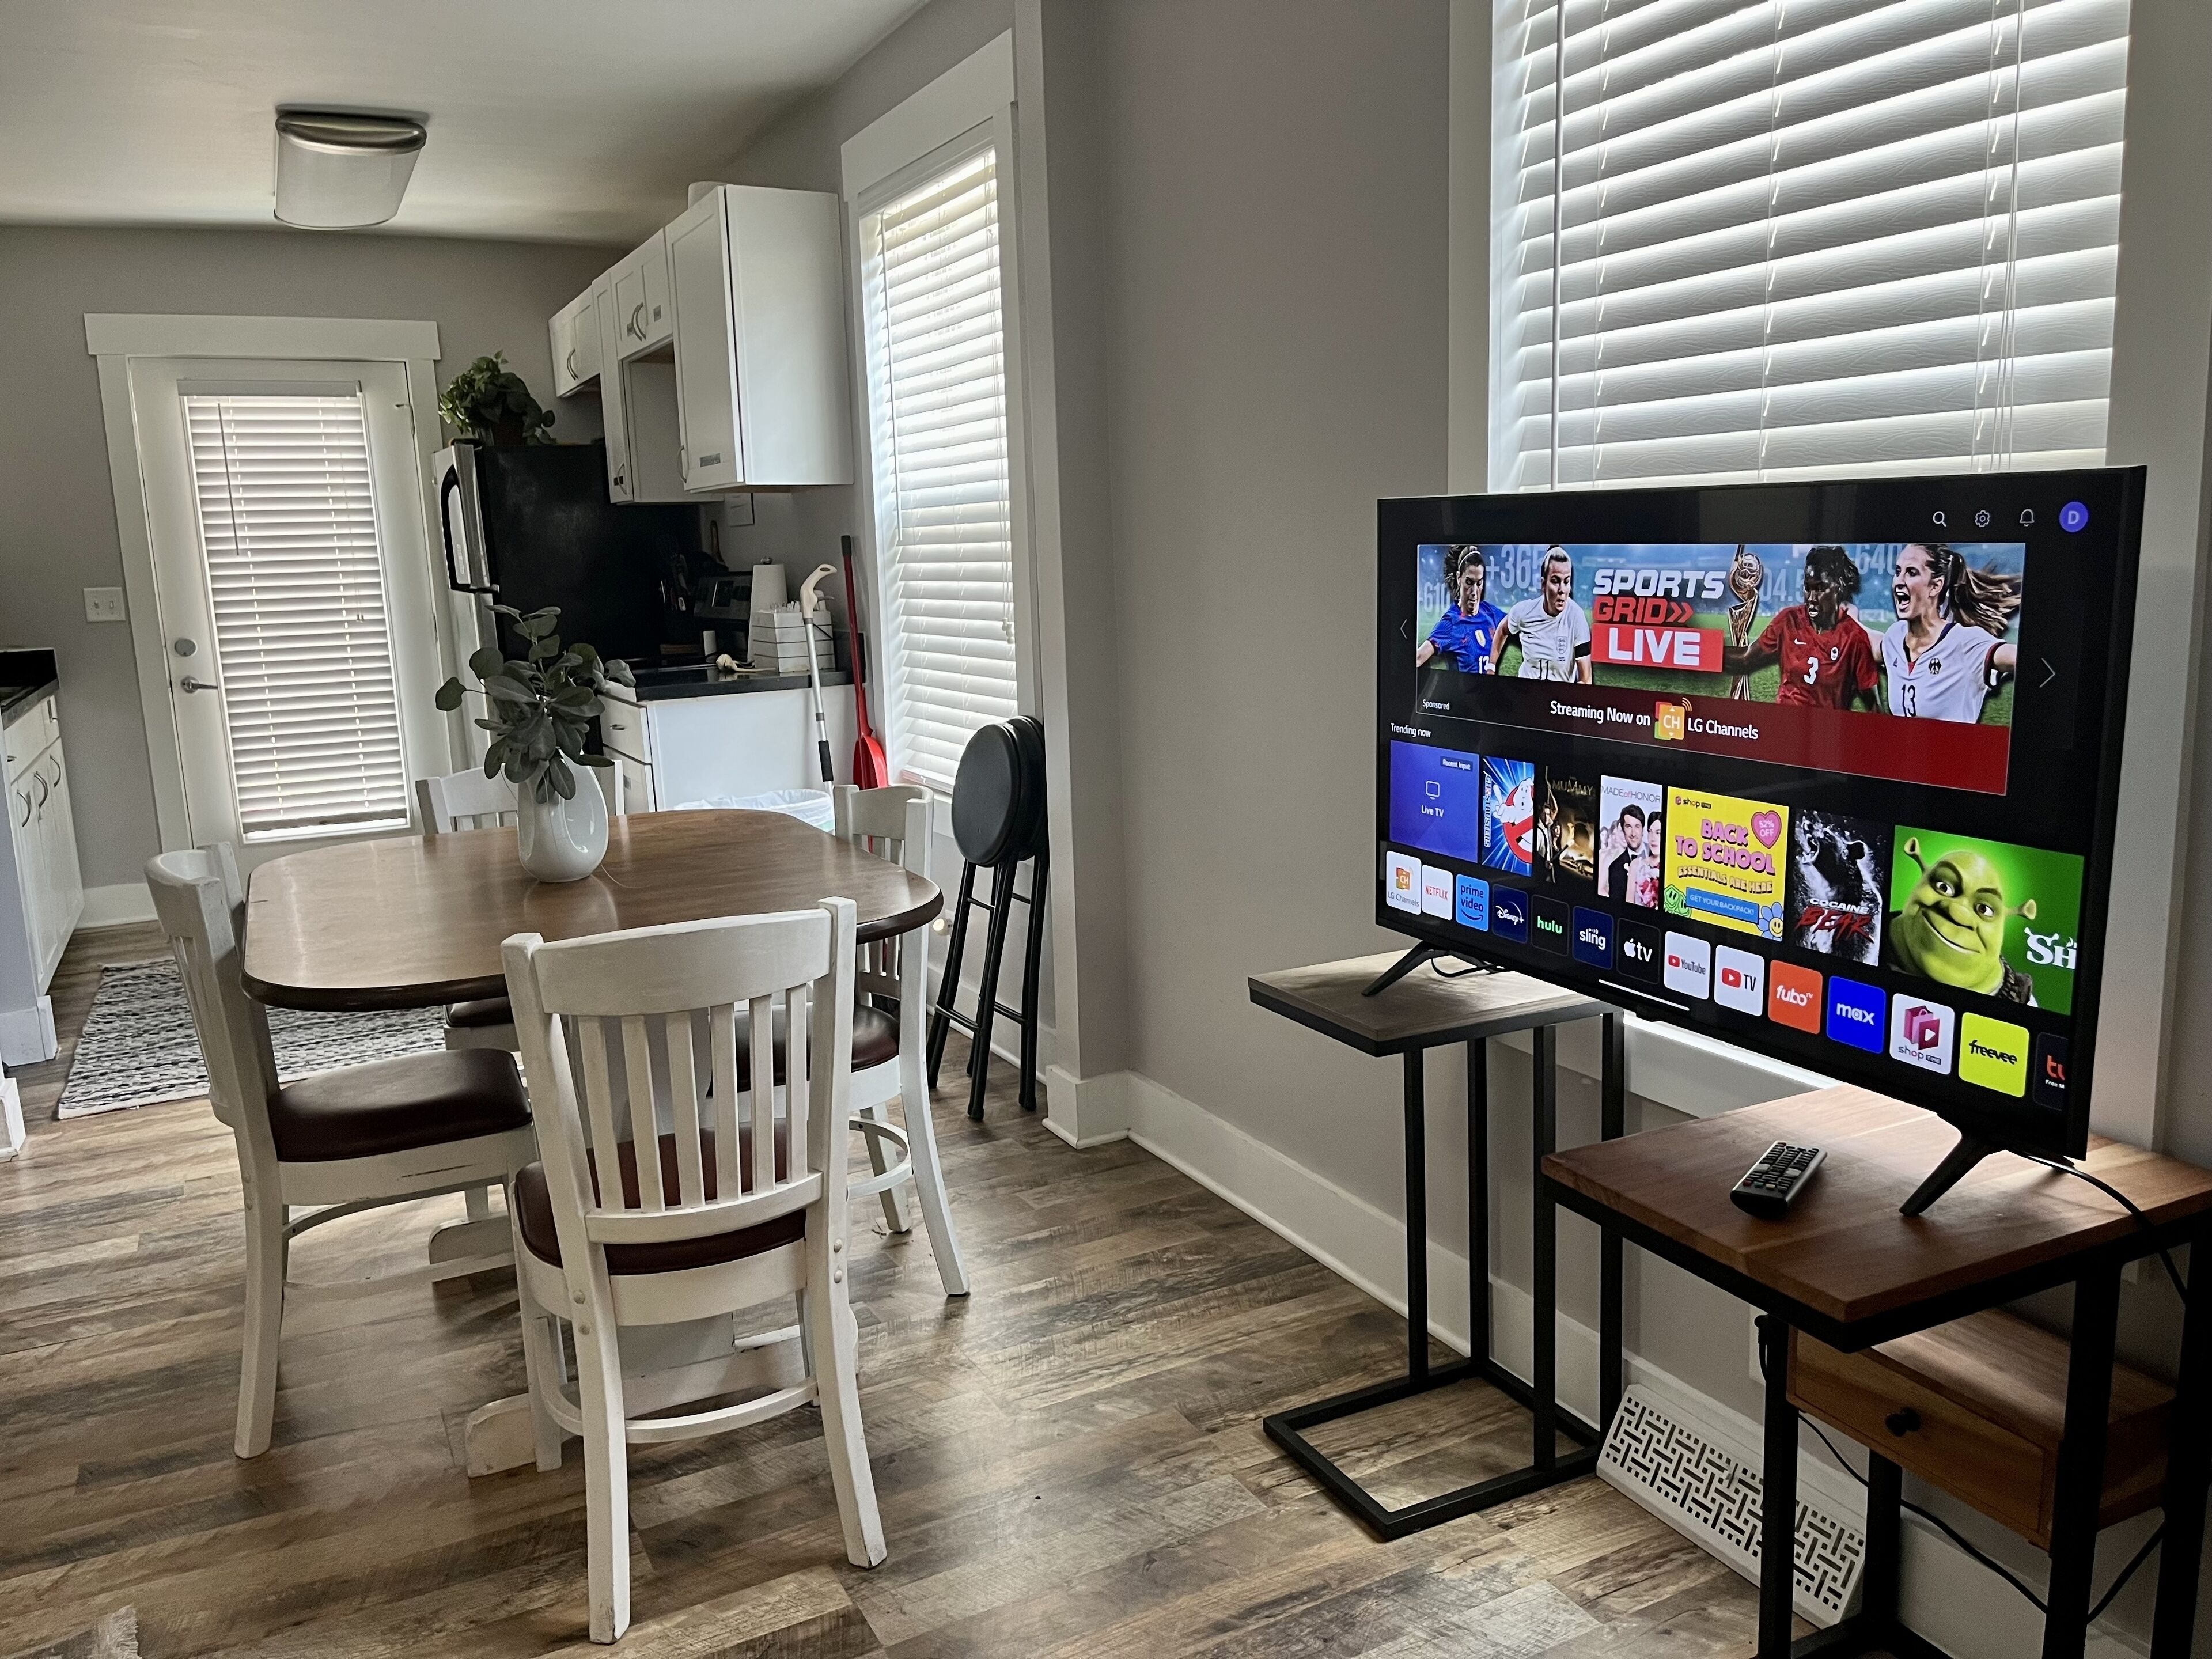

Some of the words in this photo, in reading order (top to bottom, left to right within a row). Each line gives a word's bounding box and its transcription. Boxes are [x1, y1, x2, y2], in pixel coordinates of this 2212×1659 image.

[2068, 510, 2080, 525] D
[1593, 569, 1726, 599] SPORTS
[1593, 596, 1668, 624] GRID
[1609, 628, 1700, 666] LIVE
[1539, 659, 1549, 679] 11
[1804, 657, 1819, 685] 3
[1422, 699, 1450, 710] Sponsored
[1902, 684, 1916, 717] 13
[1550, 700, 1603, 724] Streaming
[1607, 707, 1633, 724] Now
[1636, 714, 1651, 726] on
[1663, 714, 1680, 730] CH
[1688, 718, 1703, 733] LG
[1706, 720, 1758, 740] Channels
[1391, 723, 1416, 738] Trending
[1418, 729, 1431, 737] now
[1442, 759, 1458, 768] Recent
[1552, 779, 1593, 796] MUMMY
[1421, 805, 1434, 815] Live
[1435, 808, 1444, 817] TV
[1683, 797, 1700, 809] shop
[1701, 819, 1748, 847] BACK
[1675, 835, 1698, 858] TO
[1702, 842, 1776, 876] SCHOOL
[1399, 875, 1409, 885] CH
[1677, 866, 1727, 885] ESSENTIALS
[1729, 876, 1747, 892] ARE
[1748, 881, 1773, 894] HERE
[1388, 891, 1395, 900] LG
[1396, 893, 1419, 907] Channels
[1425, 885, 1448, 900] NETFLIX
[1460, 884, 1484, 899] prime
[1460, 897, 1484, 912] video
[1690, 894, 1702, 902] GET
[1702, 897, 1719, 907] YOUR
[1810, 897, 1869, 914] COCAINE
[1537, 915, 1563, 934] hulu
[1794, 906, 1874, 944] BEAR
[1579, 928, 1606, 950] sling
[1636, 942, 1653, 962] tv
[1681, 959, 1706, 975] YouTube
[1743, 974, 1756, 991] TV
[1836, 1003, 1875, 1025] max
[1899, 1045, 1924, 1061] shop
[1969, 1040, 2017, 1065] freevee
[2045, 1079, 2058, 1087] Free
